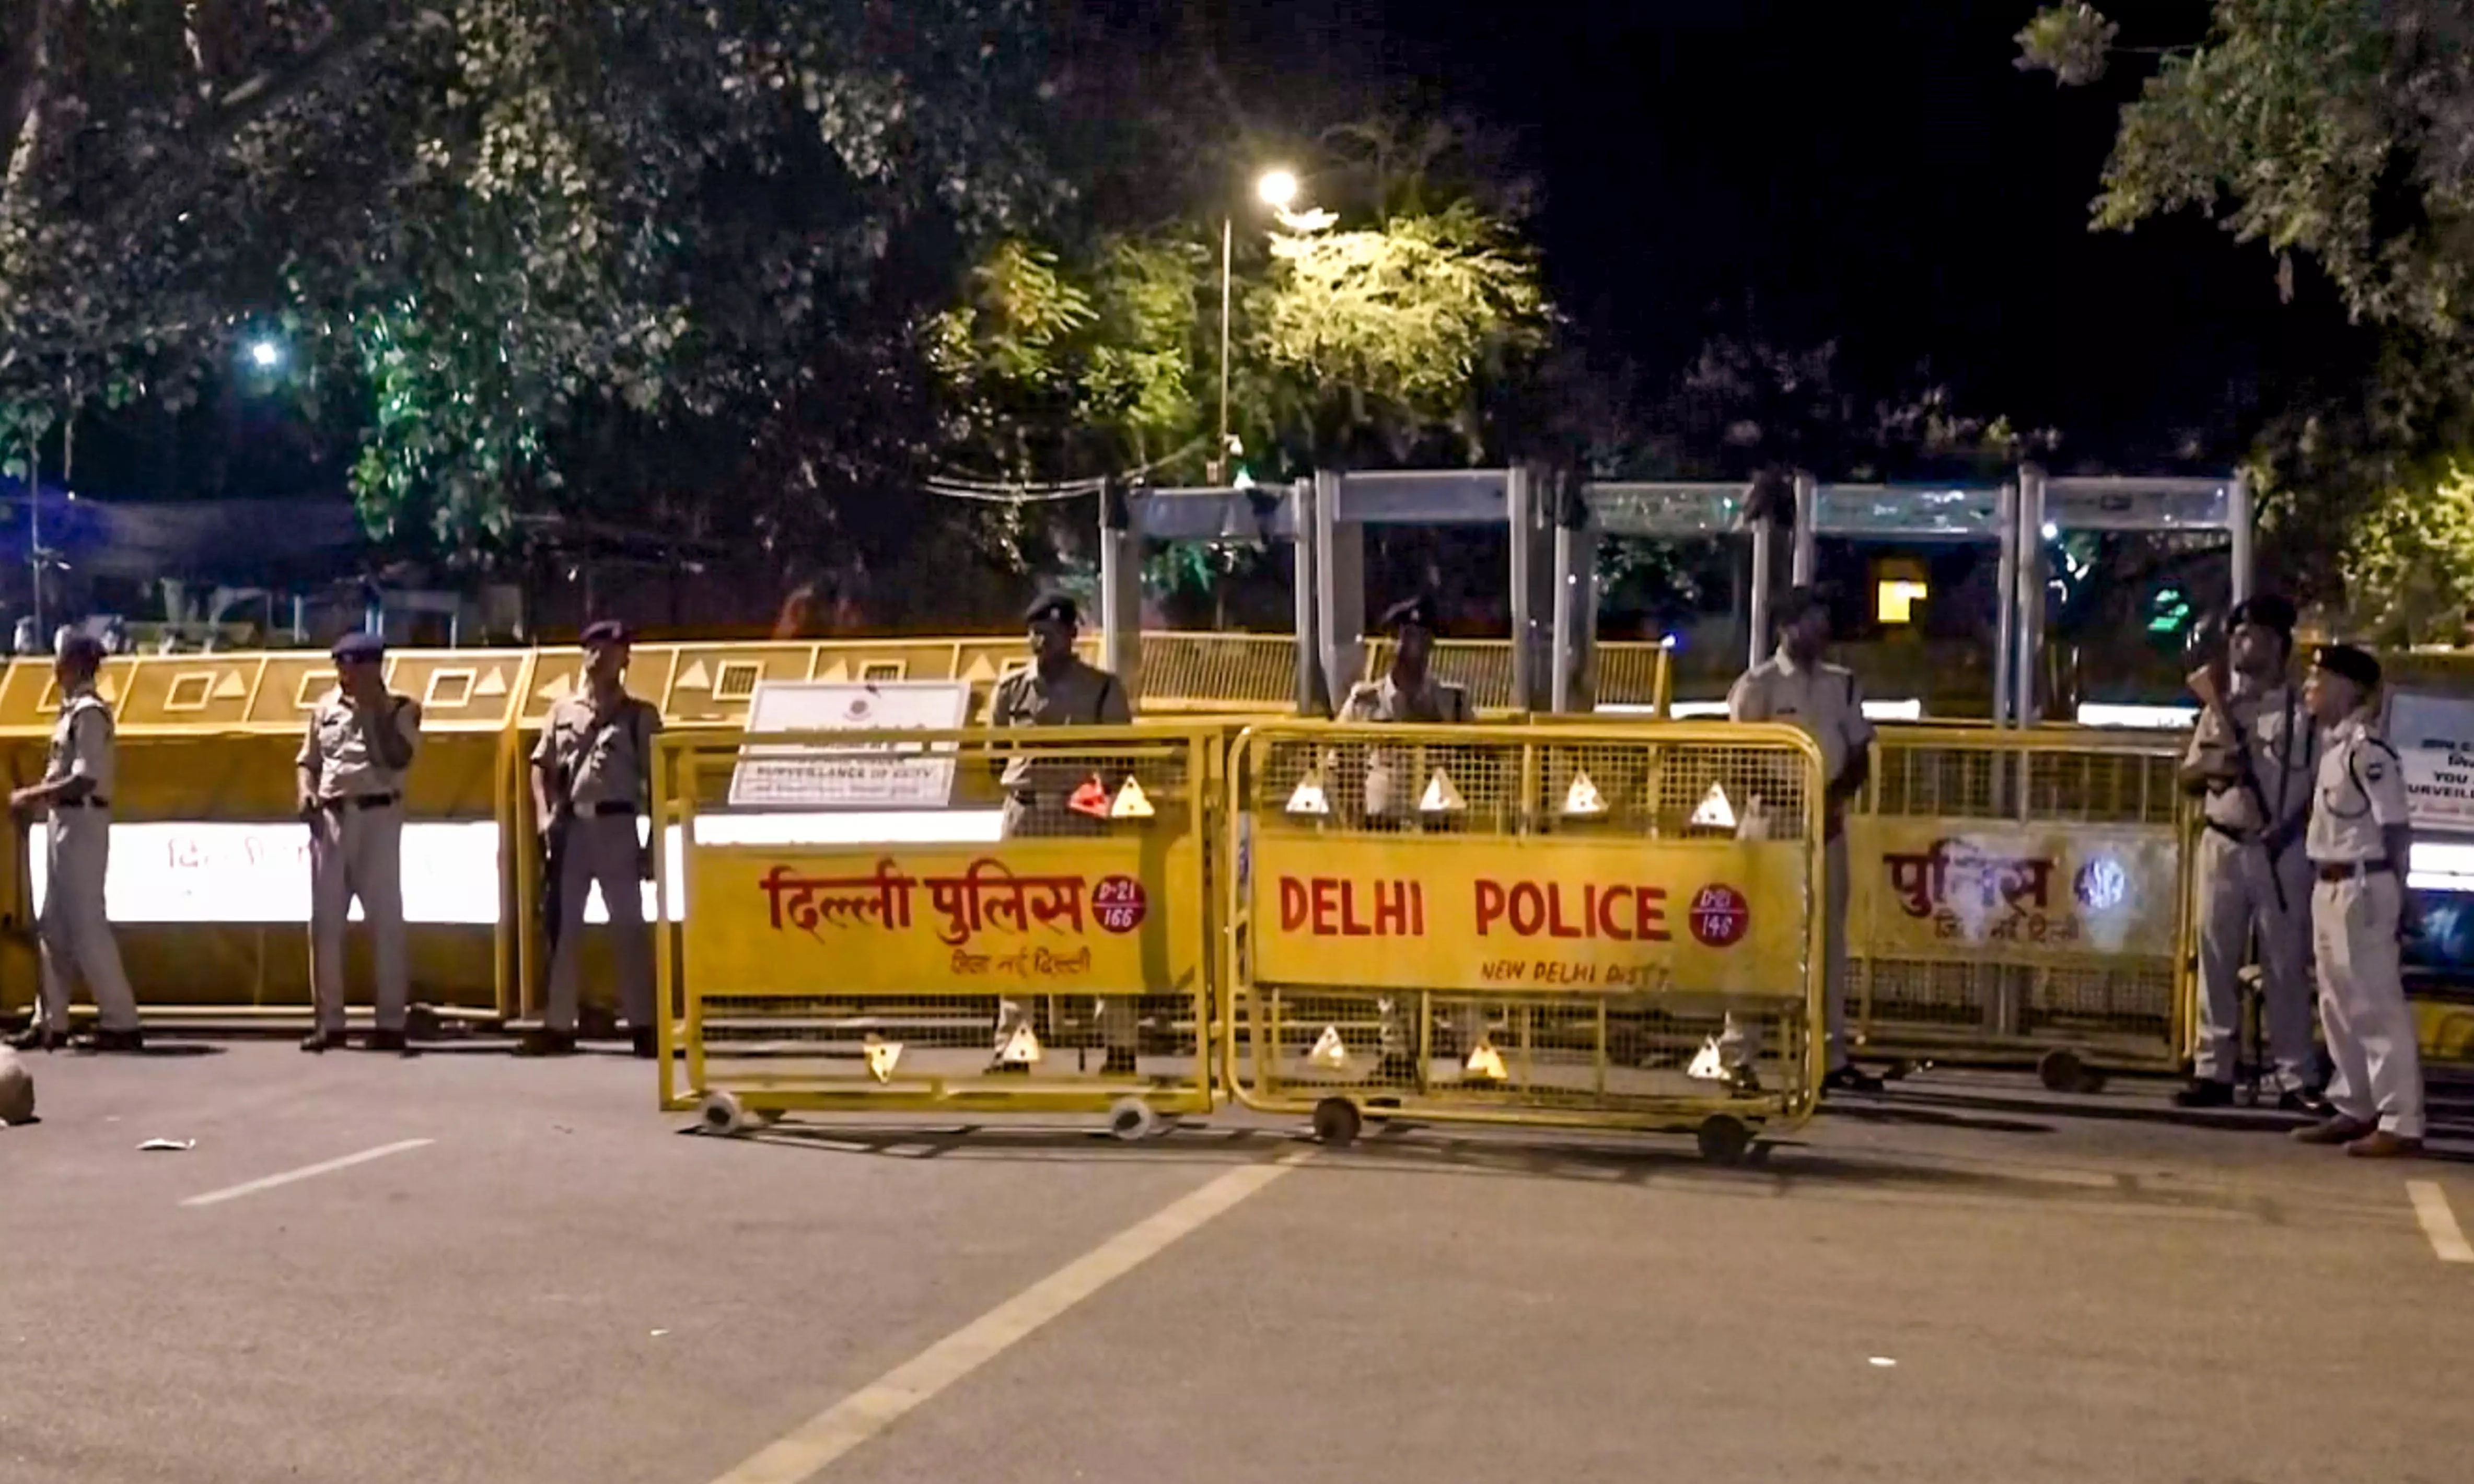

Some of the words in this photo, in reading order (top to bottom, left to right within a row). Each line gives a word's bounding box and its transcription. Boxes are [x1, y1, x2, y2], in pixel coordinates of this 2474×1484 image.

[2434, 771, 2468, 784] YOU
[760, 855, 917, 944] दिल्ली
[923, 857, 1086, 945] पुलिस
[1279, 876, 1424, 936] DELHI
[1473, 879, 1672, 941] POLICE
[1104, 908, 1134, 928] 166
[1481, 960, 1526, 980] NEW
[1533, 961, 1596, 985] DELHI
